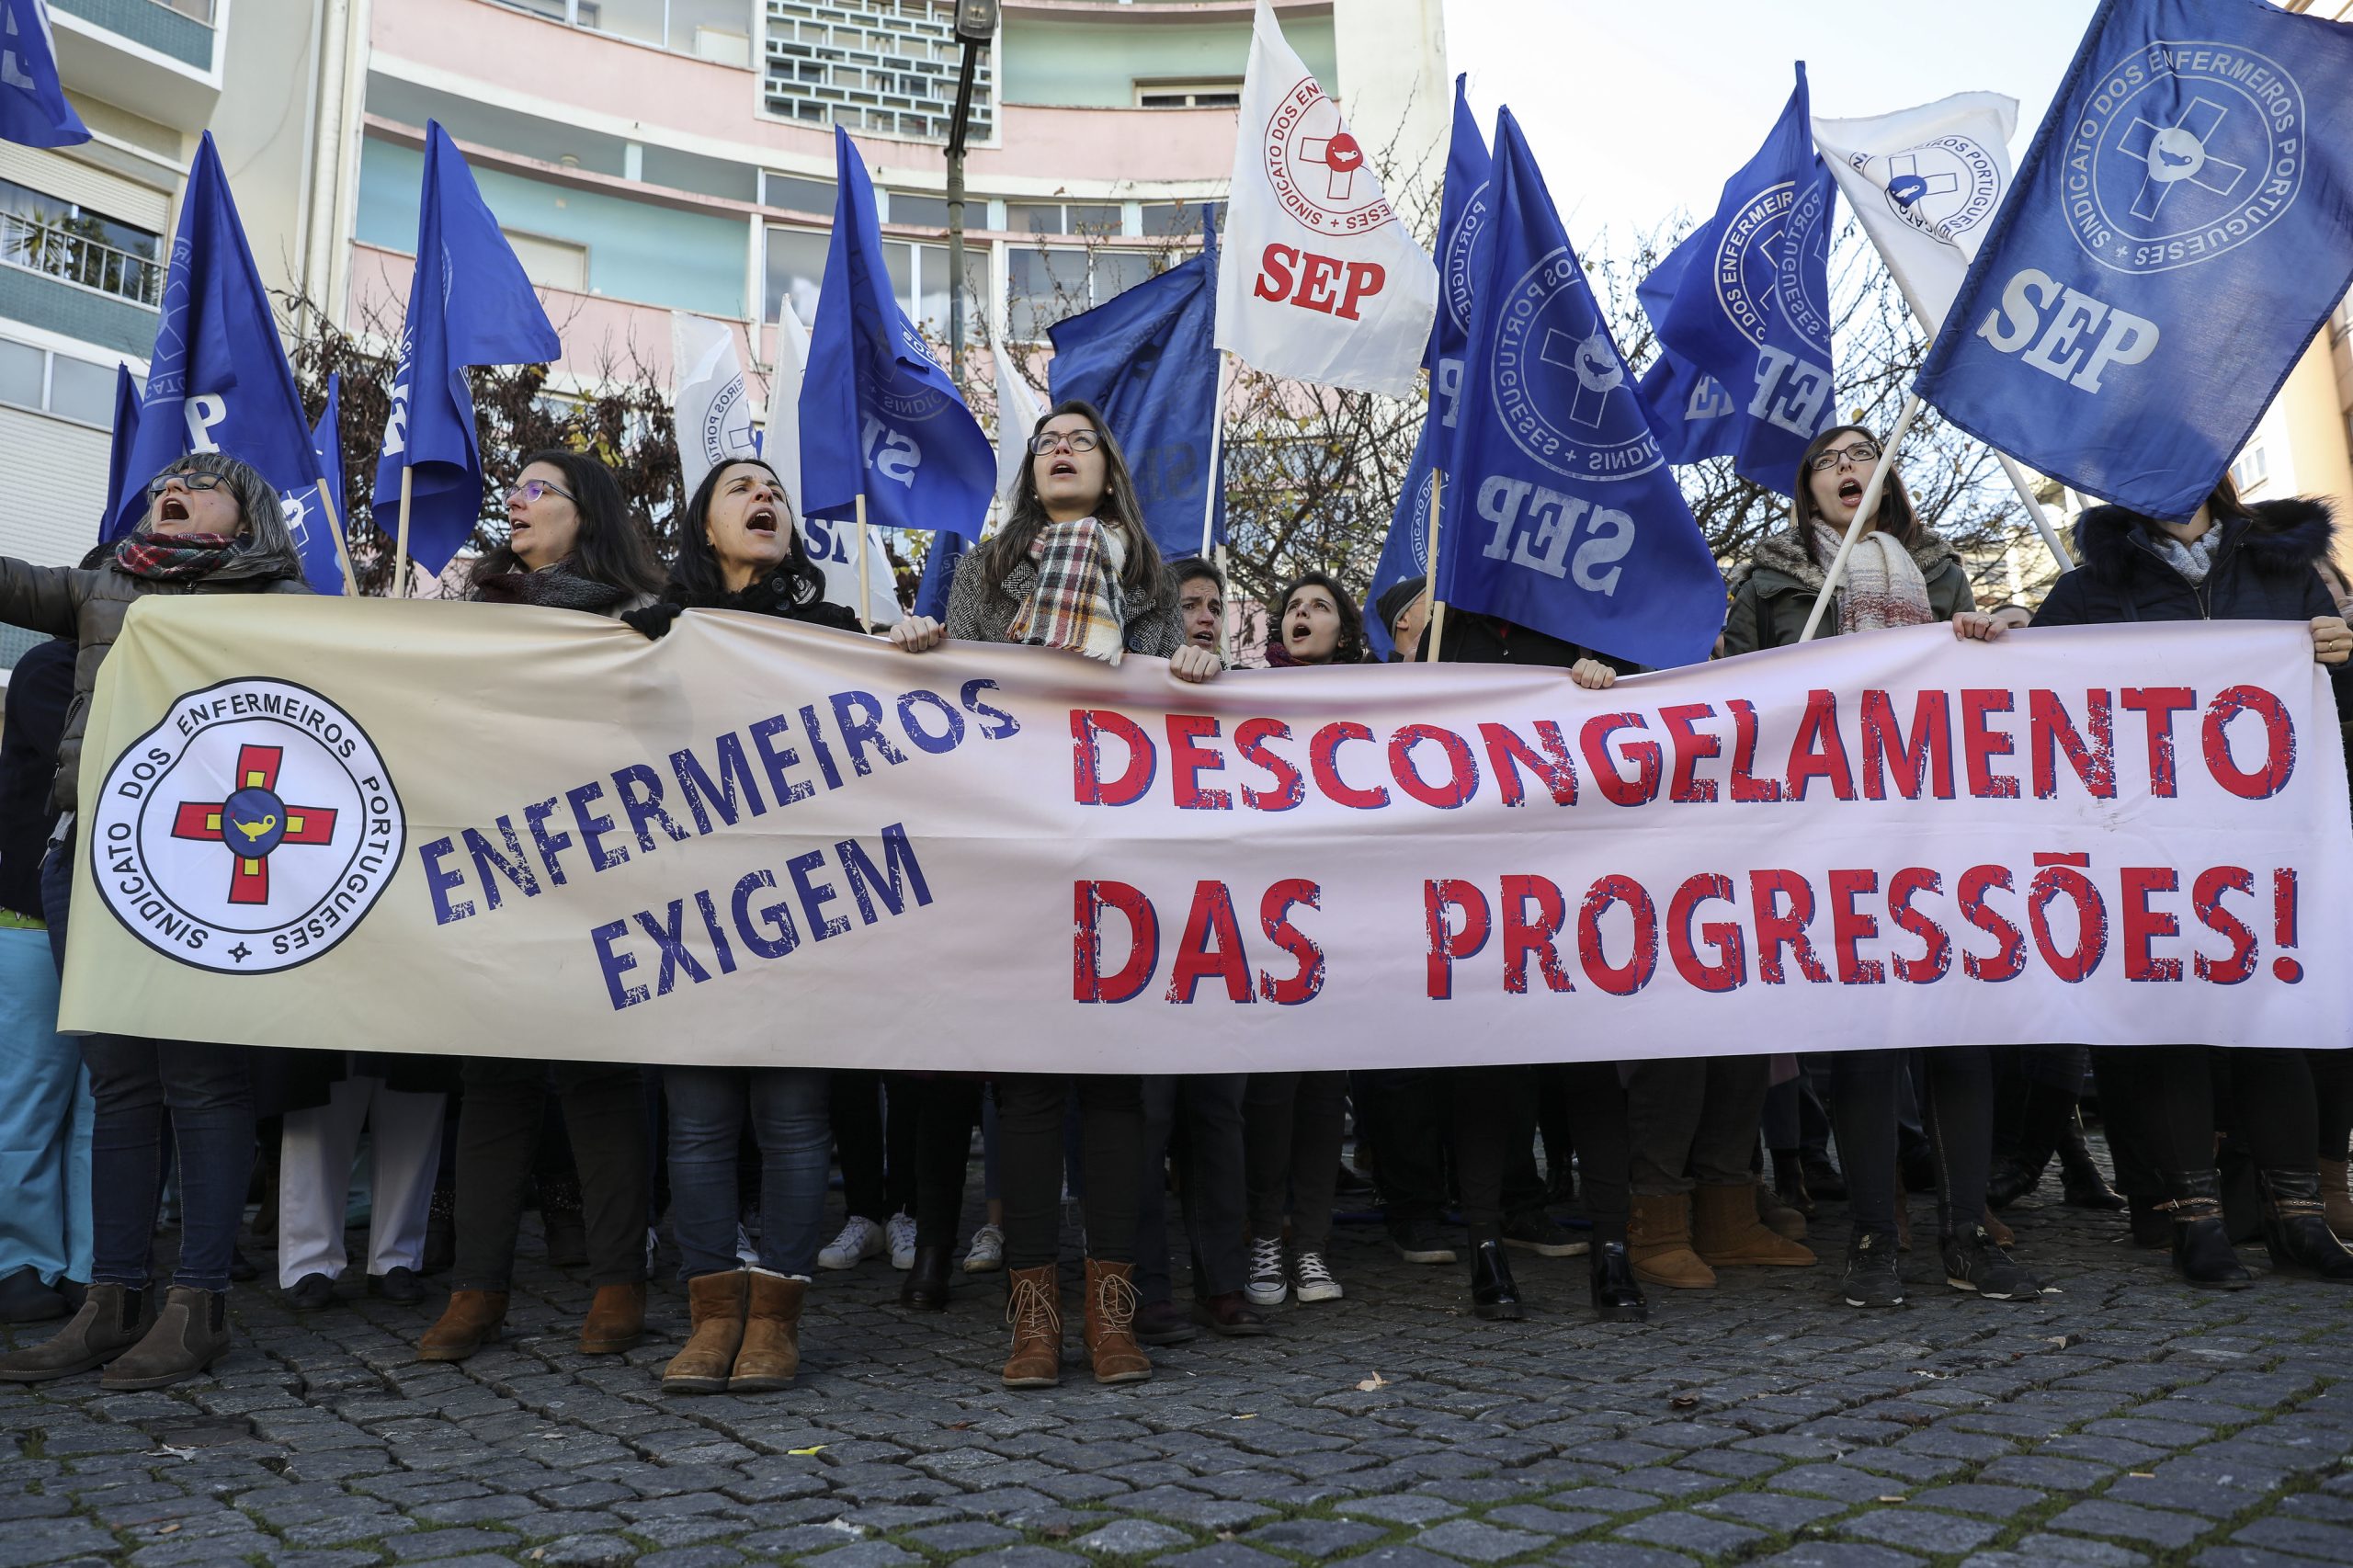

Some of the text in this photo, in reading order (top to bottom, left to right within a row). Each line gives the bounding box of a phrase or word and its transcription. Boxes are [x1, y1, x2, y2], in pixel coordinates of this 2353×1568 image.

[1268, 145, 1323, 226] SINDICATO
[1271, 104, 1299, 142] DOS
[2068, 50, 2298, 267] SINDICATO DOS ENFERMEIROS PORTUGUESES
[1253, 243, 1386, 322] SEP
[1722, 190, 1794, 327] DOS ENFERMEIR
[1975, 267, 2161, 395] SEP
[418, 678, 1021, 926] ENFERMEIROS
[1069, 684, 2297, 812] DESCONGELAMENTO
[107, 693, 392, 955] SINDICATO DOS ENFERMEIROS PORTUGUESES
[590, 822, 934, 1011] EXIGEM
[1073, 851, 2304, 1005] DAS PROGRESSÕES!
